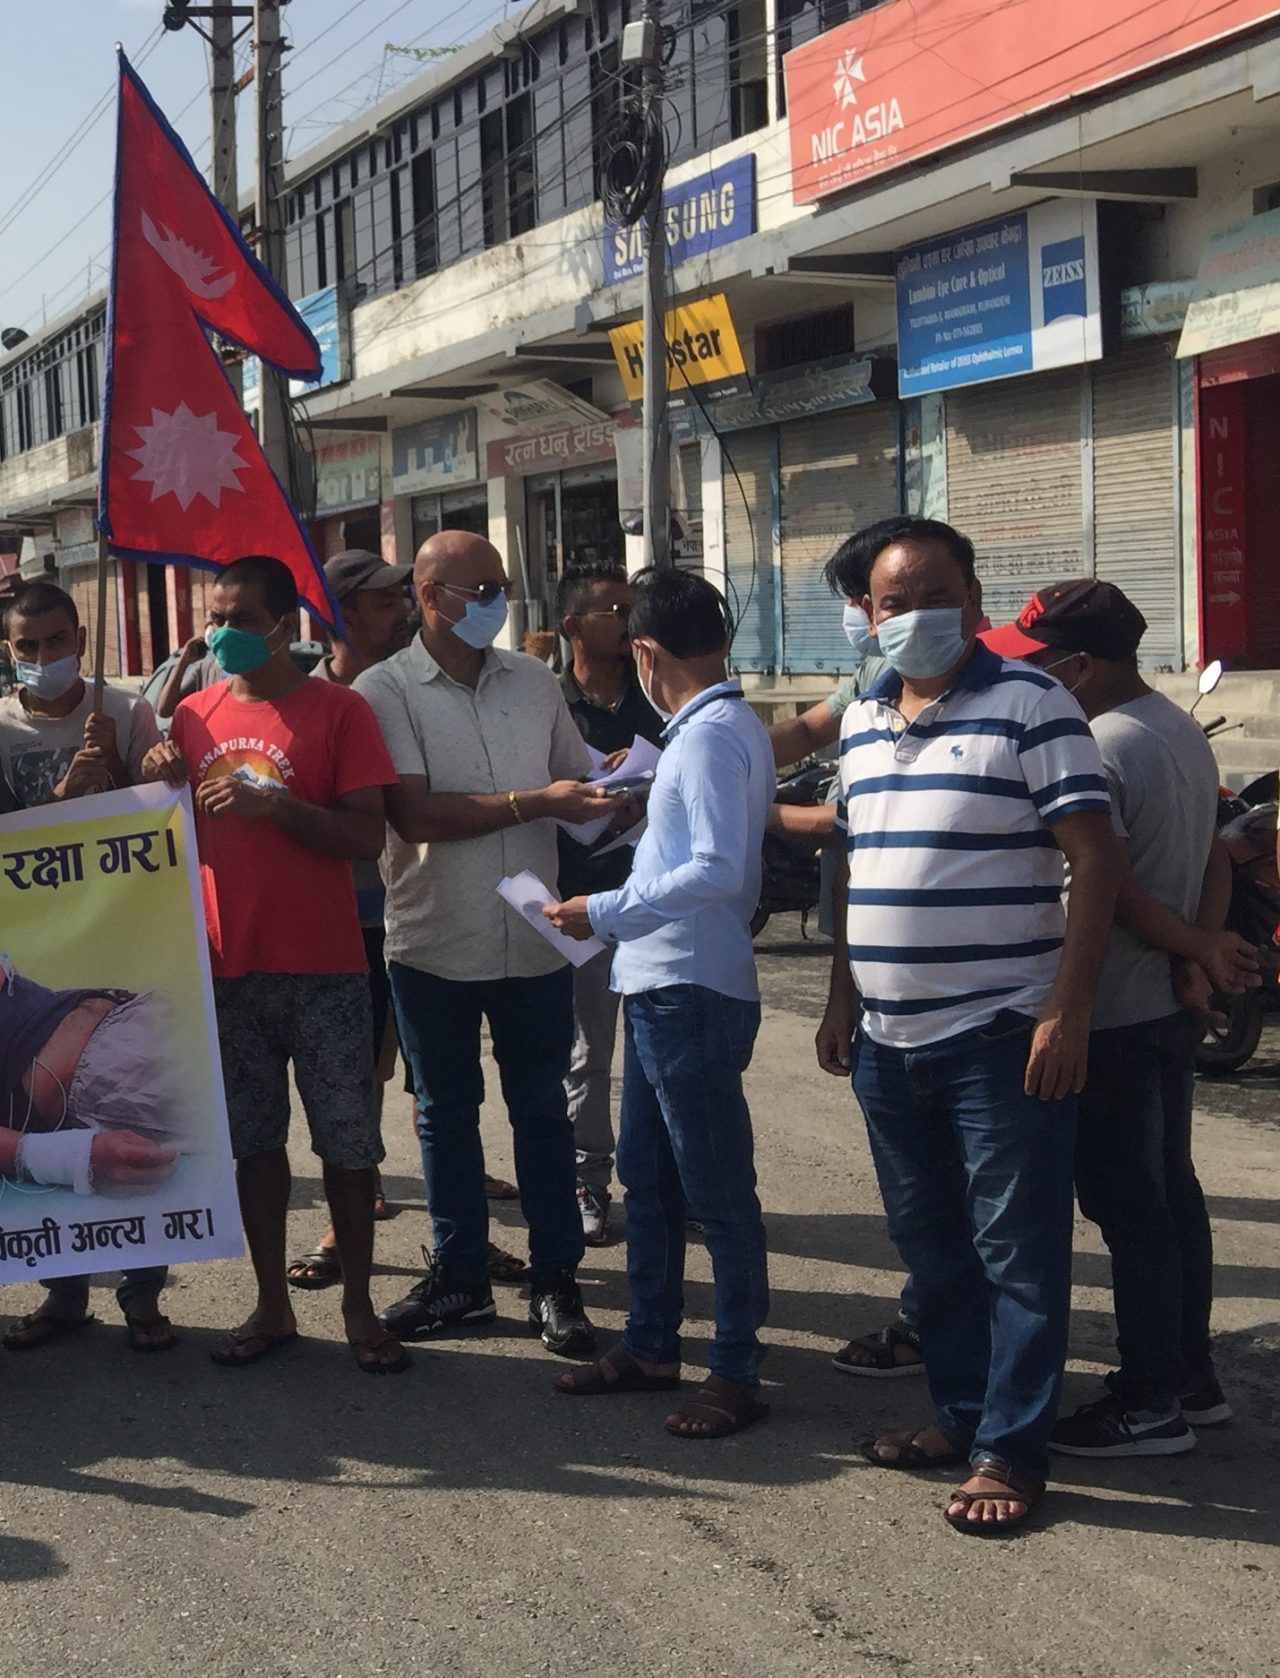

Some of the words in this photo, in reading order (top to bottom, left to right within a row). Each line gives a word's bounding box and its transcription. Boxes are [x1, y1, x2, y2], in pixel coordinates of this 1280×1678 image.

[811, 120, 846, 168] NIC
[851, 97, 904, 151] ASIA
[614, 181, 735, 266] SASUNG
[937, 280, 950, 298] Eye
[951, 275, 968, 293] Care
[969, 270, 976, 288] &
[978, 261, 1006, 287] Optical
[1043, 258, 1084, 288] ZEISS
[623, 328, 722, 379] Hstar
[504, 437, 537, 466] रत्न
[1206, 527, 1239, 541] ASIA
[198, 737, 264, 779] ANNAPURNA
[266, 744, 295, 779] TREK
[3, 843, 84, 890] रक्षा
[96, 828, 178, 874] गर।
[68, 1215, 146, 1254] अन्त्य
[162, 1207, 215, 1241] गर।
